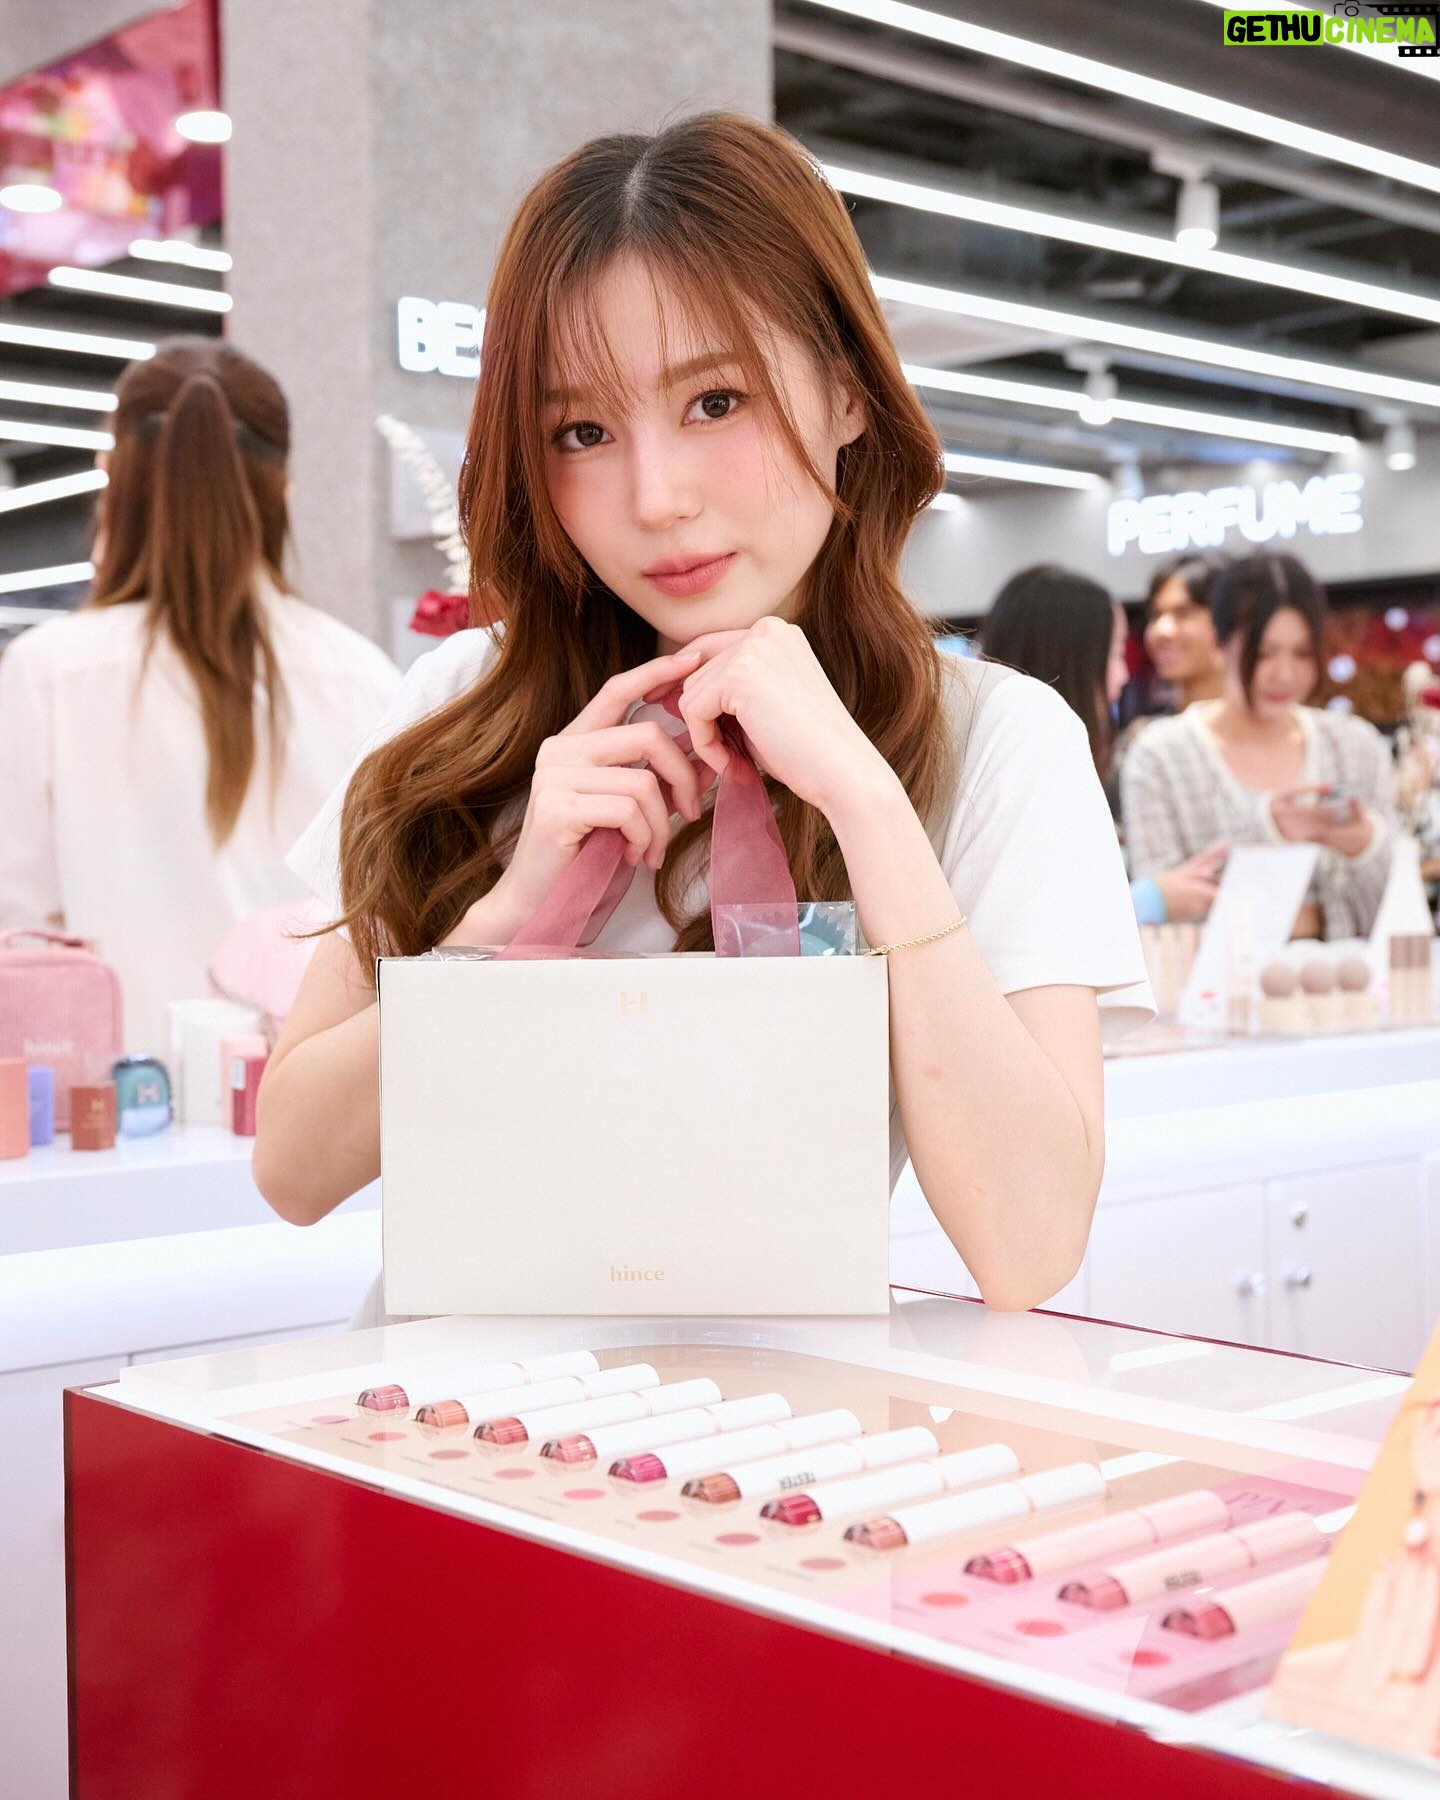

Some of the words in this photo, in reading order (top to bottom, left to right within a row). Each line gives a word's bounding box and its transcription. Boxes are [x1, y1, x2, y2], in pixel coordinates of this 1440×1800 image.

[397, 296, 487, 378] BE
[1107, 472, 1365, 557] PERFUME
[609, 1264, 664, 1282] hince
